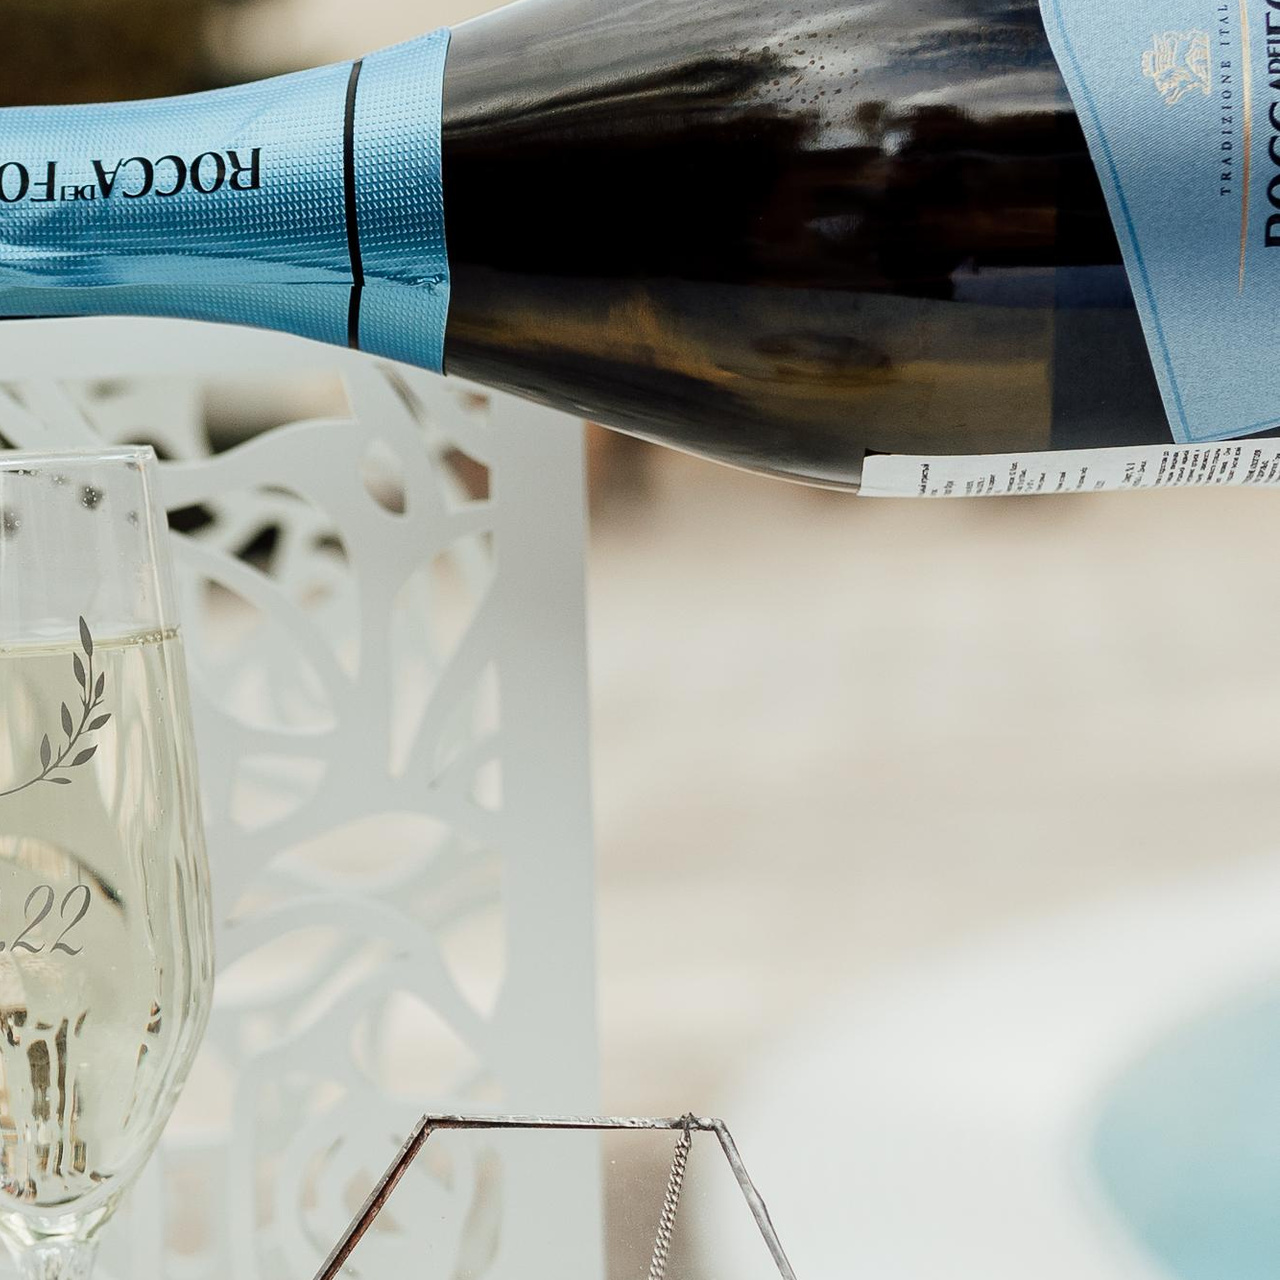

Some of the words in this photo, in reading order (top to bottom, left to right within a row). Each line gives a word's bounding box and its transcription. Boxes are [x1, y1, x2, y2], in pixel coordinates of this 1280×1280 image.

[1220, 59, 1234, 198] TRADIZIONE
[60, 184, 96, 202] DEI
[92, 147, 262, 199] ROCCA
